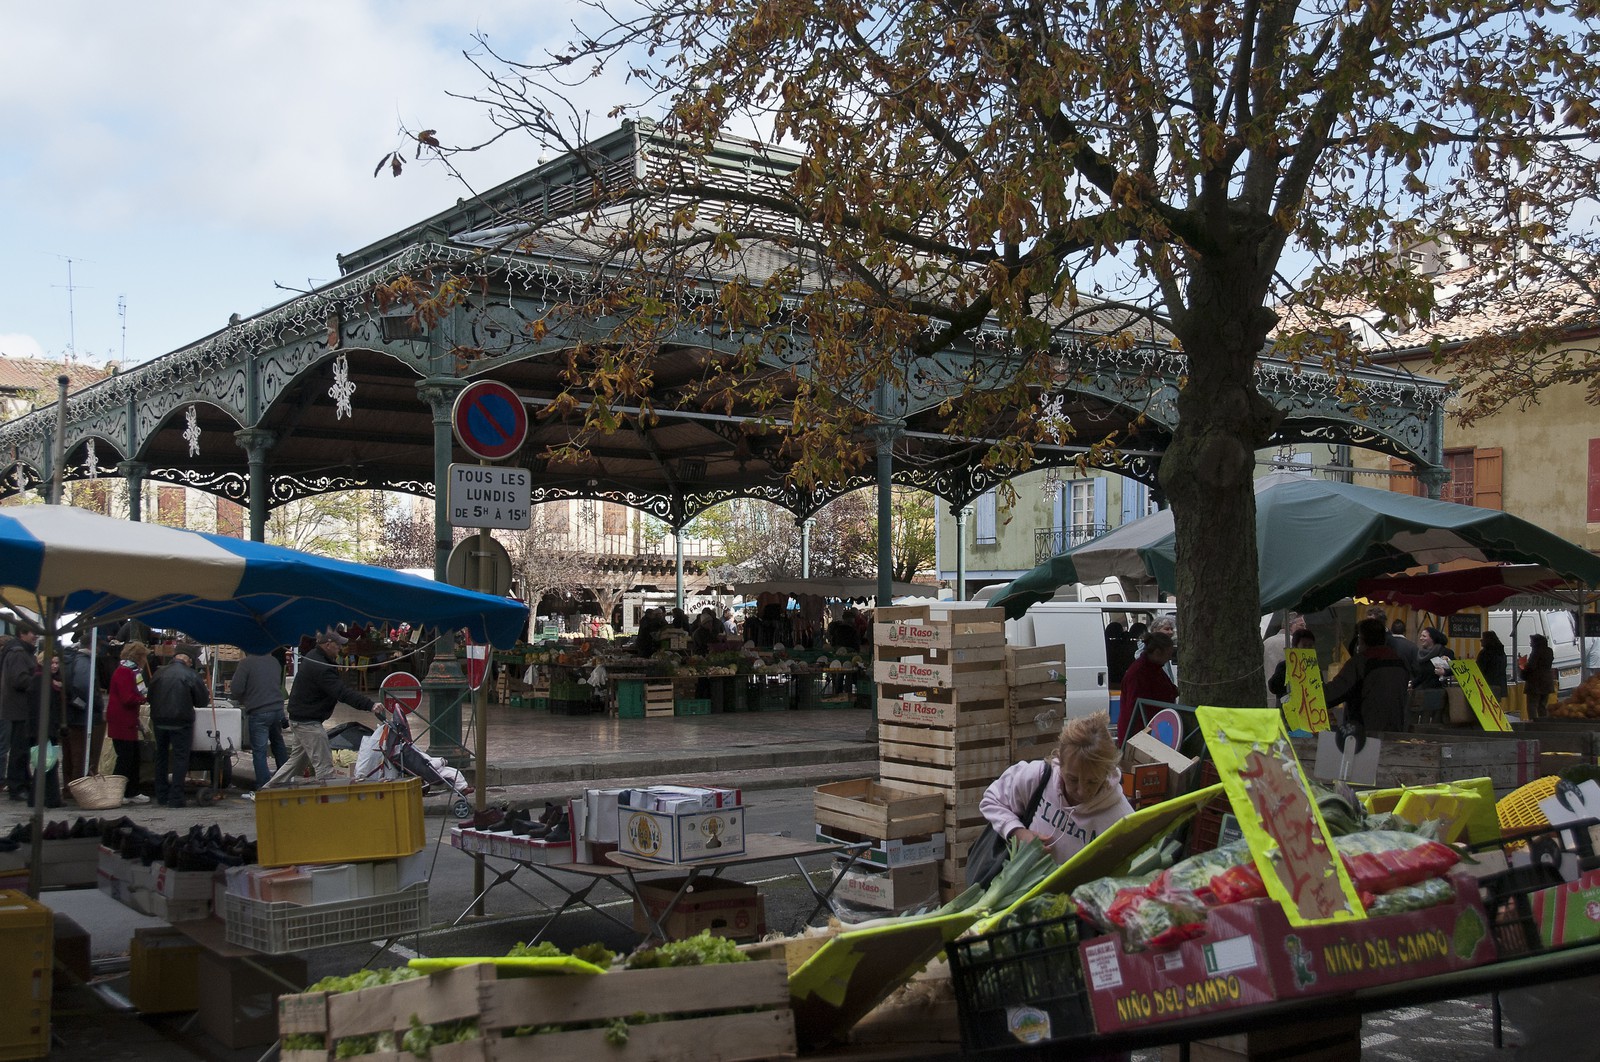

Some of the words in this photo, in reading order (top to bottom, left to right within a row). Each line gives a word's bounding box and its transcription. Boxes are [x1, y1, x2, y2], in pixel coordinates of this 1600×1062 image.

[458, 470, 493, 484] TOUS
[501, 473, 526, 486] LES
[467, 488, 516, 503] LUNDIS
[455, 508, 468, 518] DE
[473, 505, 489, 518] 5H
[495, 508, 502, 520] À
[508, 509, 527, 521] 15H
[898, 626, 907, 636] El
[910, 626, 933, 638] Raso
[898, 664, 907, 674] El
[910, 665, 933, 677] Raso
[902, 702, 912, 713] El
[914, 703, 938, 715] Raso
[1324, 937, 1363, 974] NIÑO
[1364, 939, 1395, 969] DEL
[1398, 929, 1448, 963] CAMPO
[1117, 989, 1151, 1021] NIÑO
[1153, 986, 1184, 1015] DEL
[1186, 974, 1240, 1008] CAMPO
